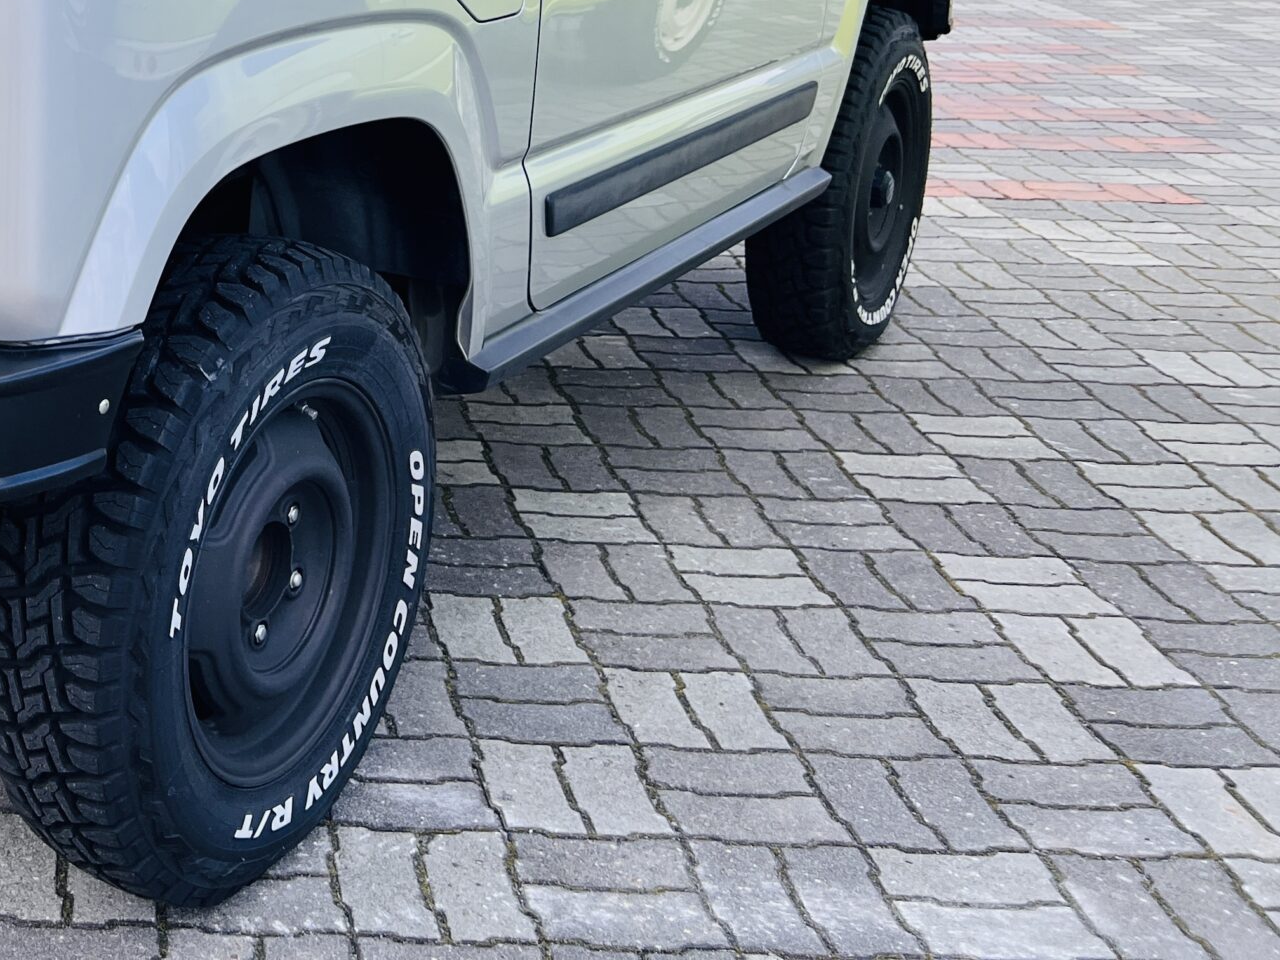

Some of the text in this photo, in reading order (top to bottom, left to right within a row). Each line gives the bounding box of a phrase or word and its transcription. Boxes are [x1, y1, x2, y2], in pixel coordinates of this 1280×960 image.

[905, 54, 929, 93] TIRES
[169, 335, 332, 639] TOYO TIRES
[234, 449, 425, 840] OPEN COUNTRY R/T
